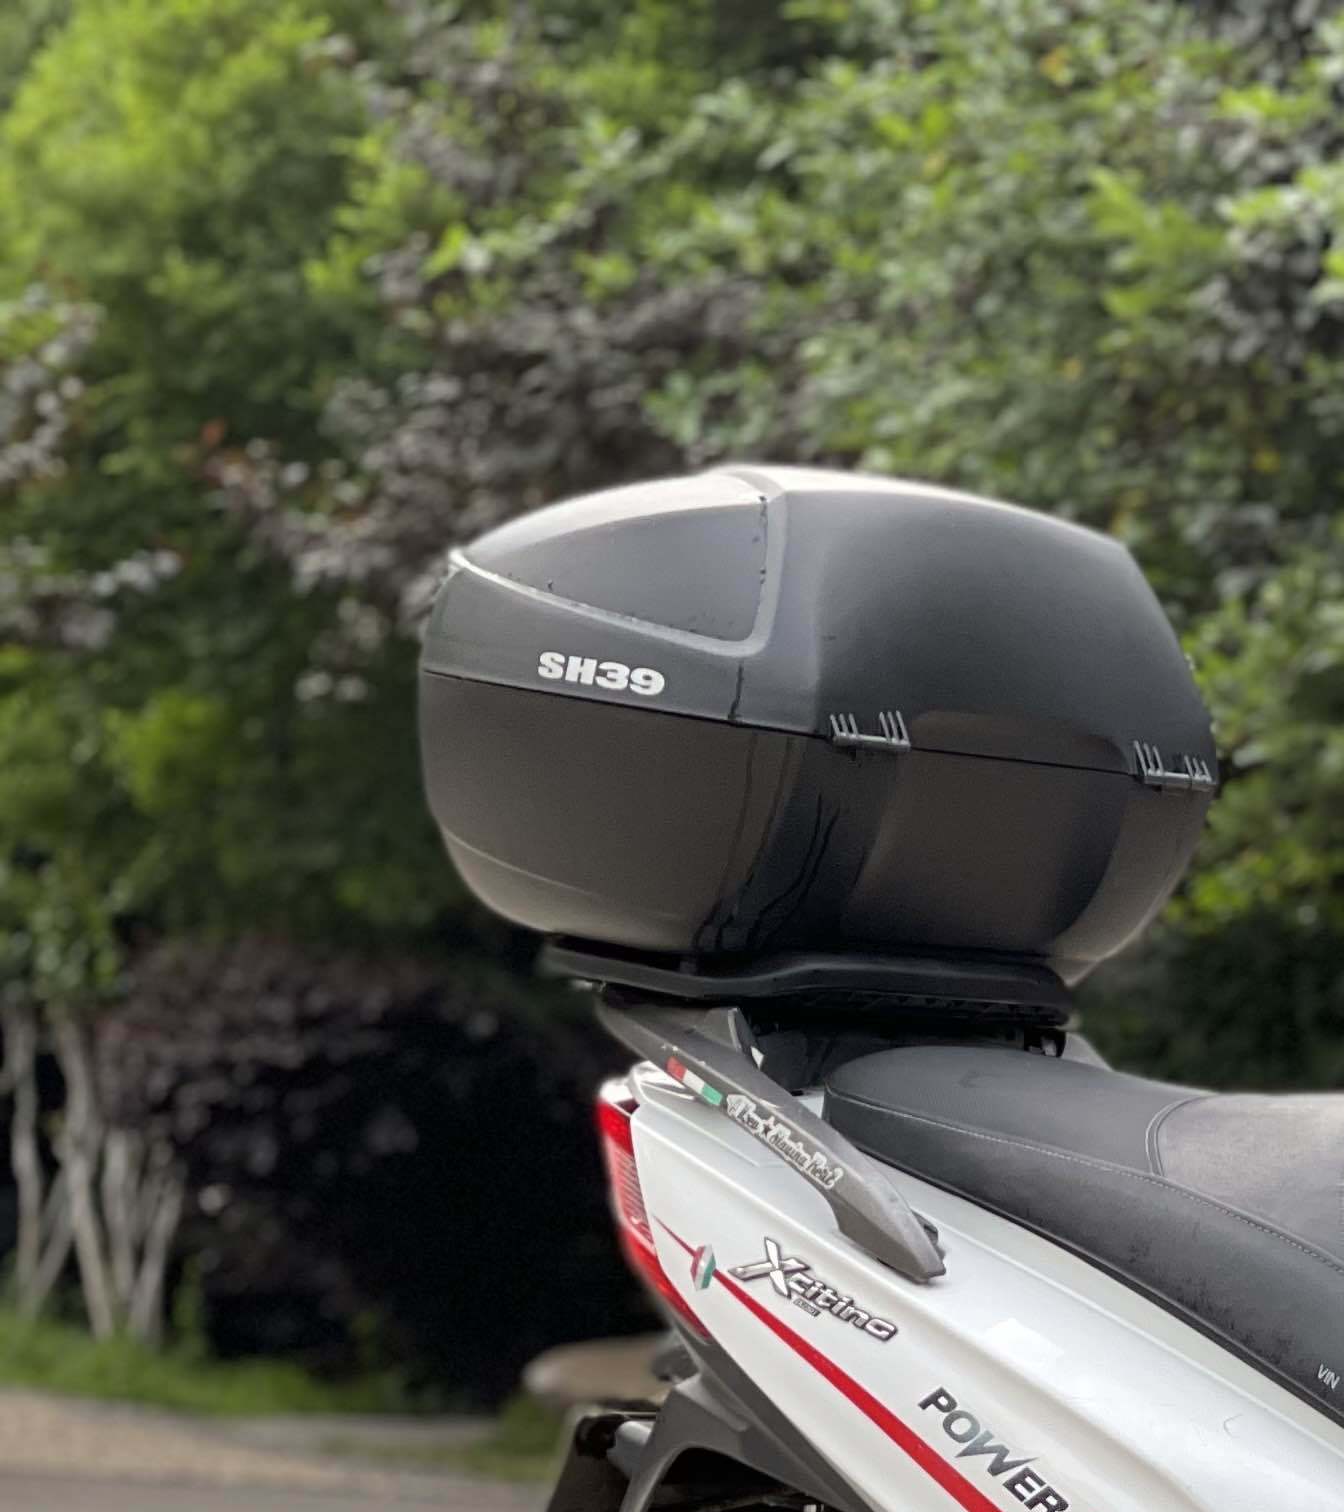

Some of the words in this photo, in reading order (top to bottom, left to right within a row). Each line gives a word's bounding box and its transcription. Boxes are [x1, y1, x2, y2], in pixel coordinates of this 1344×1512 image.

[538, 651, 665, 696] SH39
[728, 1236, 899, 1342] Xciting
[1317, 1363, 1341, 1390] VIN
